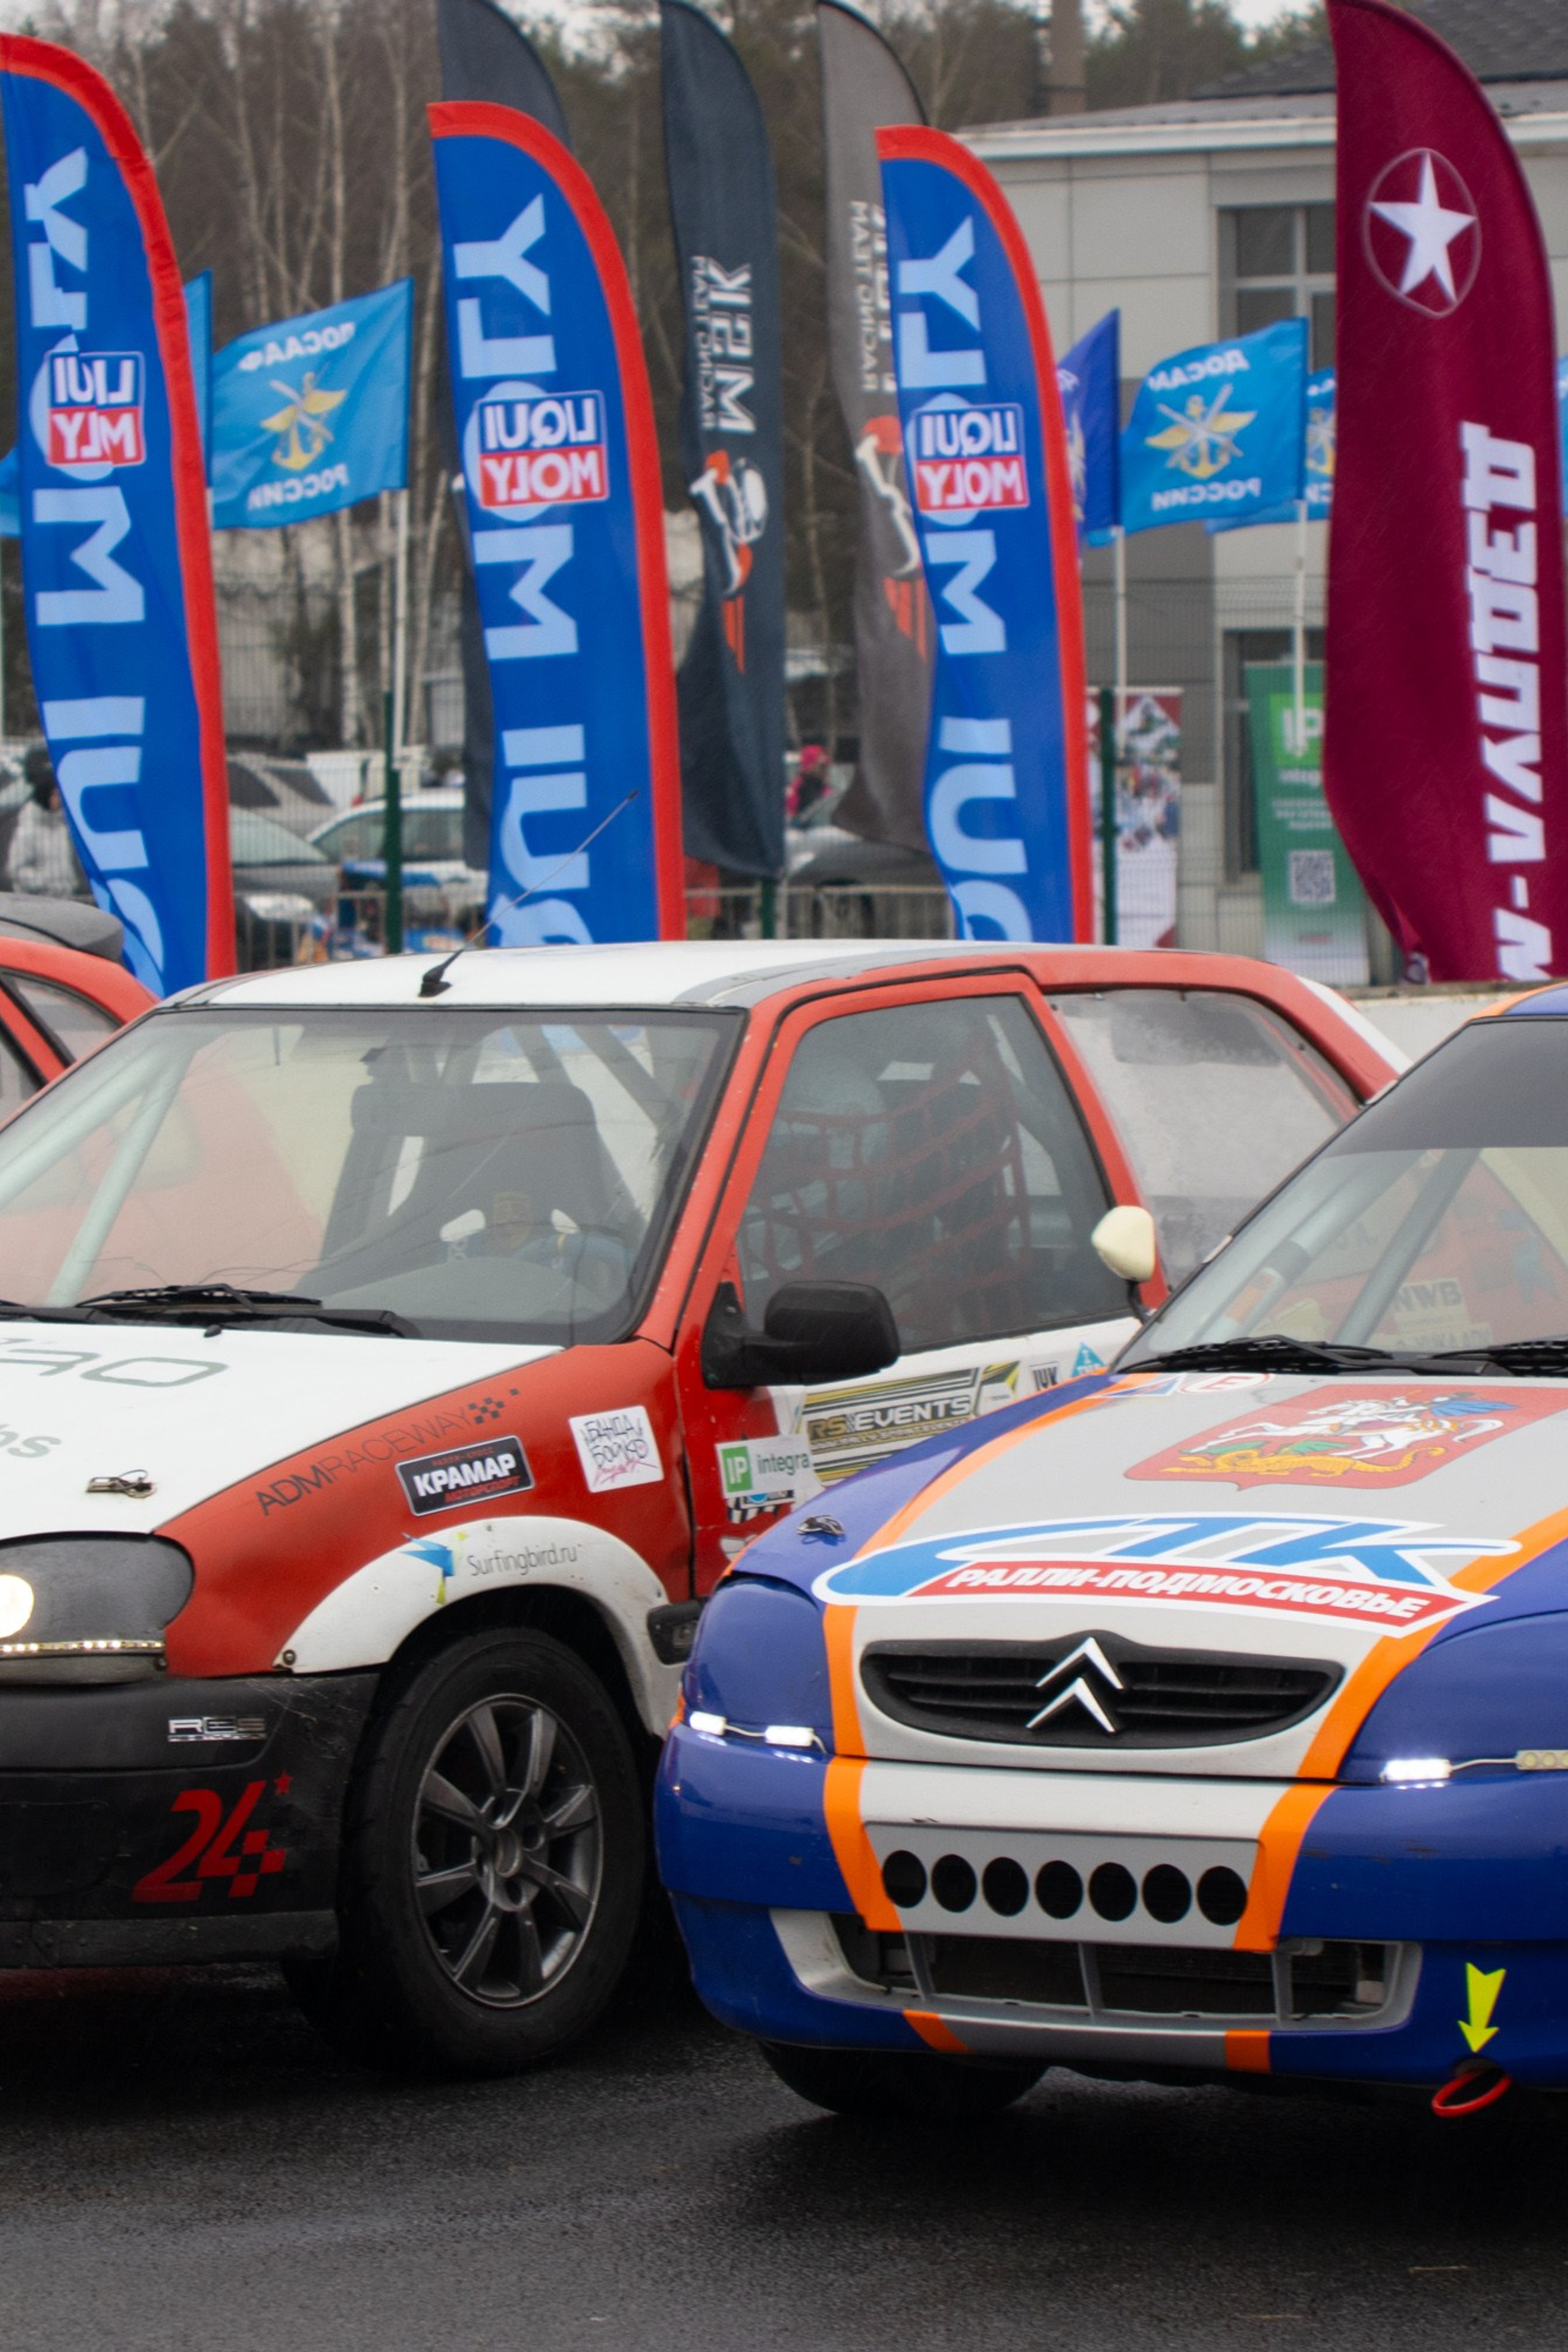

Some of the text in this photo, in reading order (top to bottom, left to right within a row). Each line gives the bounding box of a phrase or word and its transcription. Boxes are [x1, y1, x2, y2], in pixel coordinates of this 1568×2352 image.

[854, 1395, 971, 1431] EVENTS
[413, 1453, 516, 1496] КРАМАР
[726, 1457, 748, 1484] IP
[756, 1453, 810, 1476] integra
[467, 1543, 578, 1576] Surfingbird.ru
[947, 1566, 1430, 1619] РАЛЛИ-ПОДМОСКОВЬЕ
[130, 1779, 287, 1902] 24
